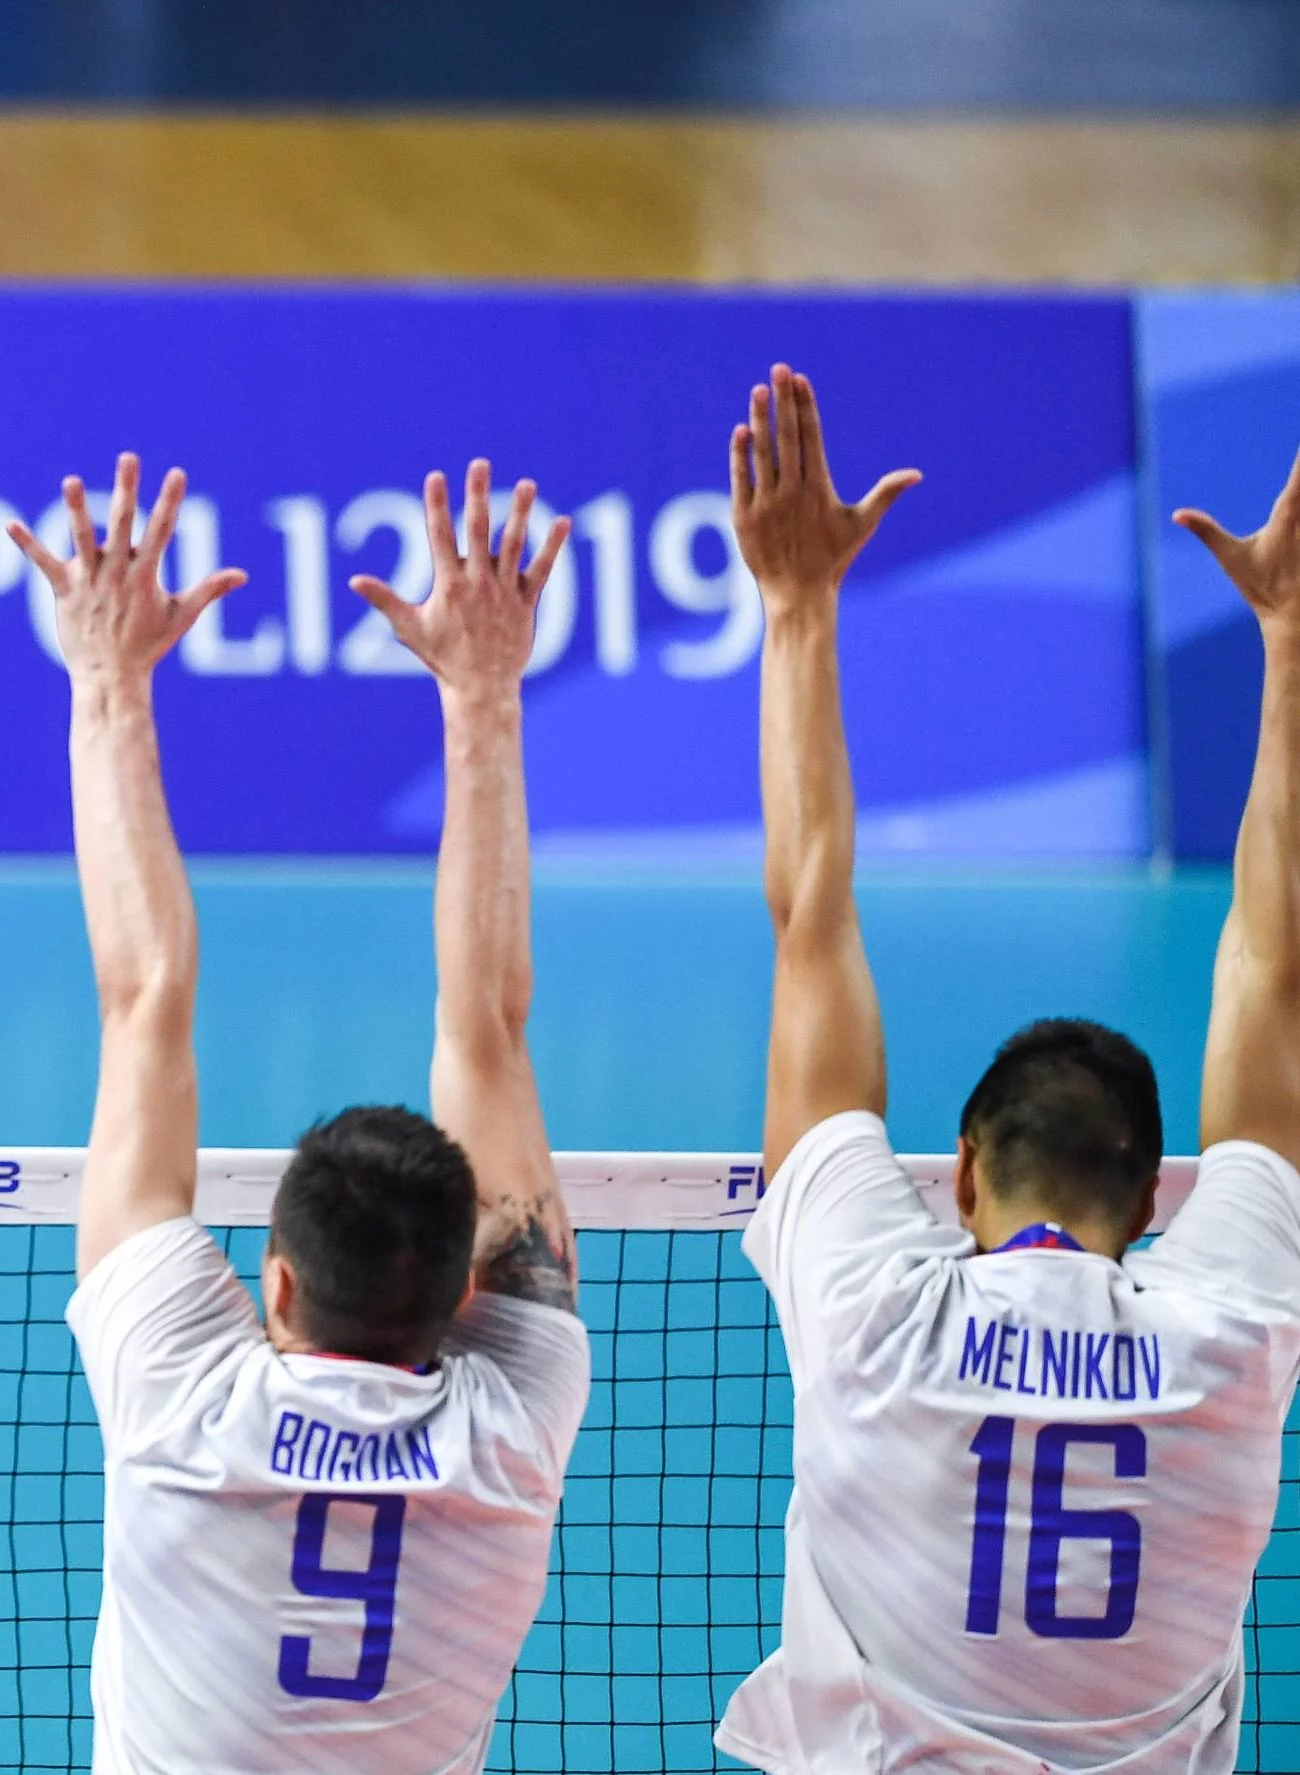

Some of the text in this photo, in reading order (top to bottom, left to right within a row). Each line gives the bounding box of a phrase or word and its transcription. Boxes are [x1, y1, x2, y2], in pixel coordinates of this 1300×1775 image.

[958, 1316, 1161, 1400] MELNIKOV
[277, 1492, 407, 1703] 9
[964, 1414, 1147, 1639] 16
